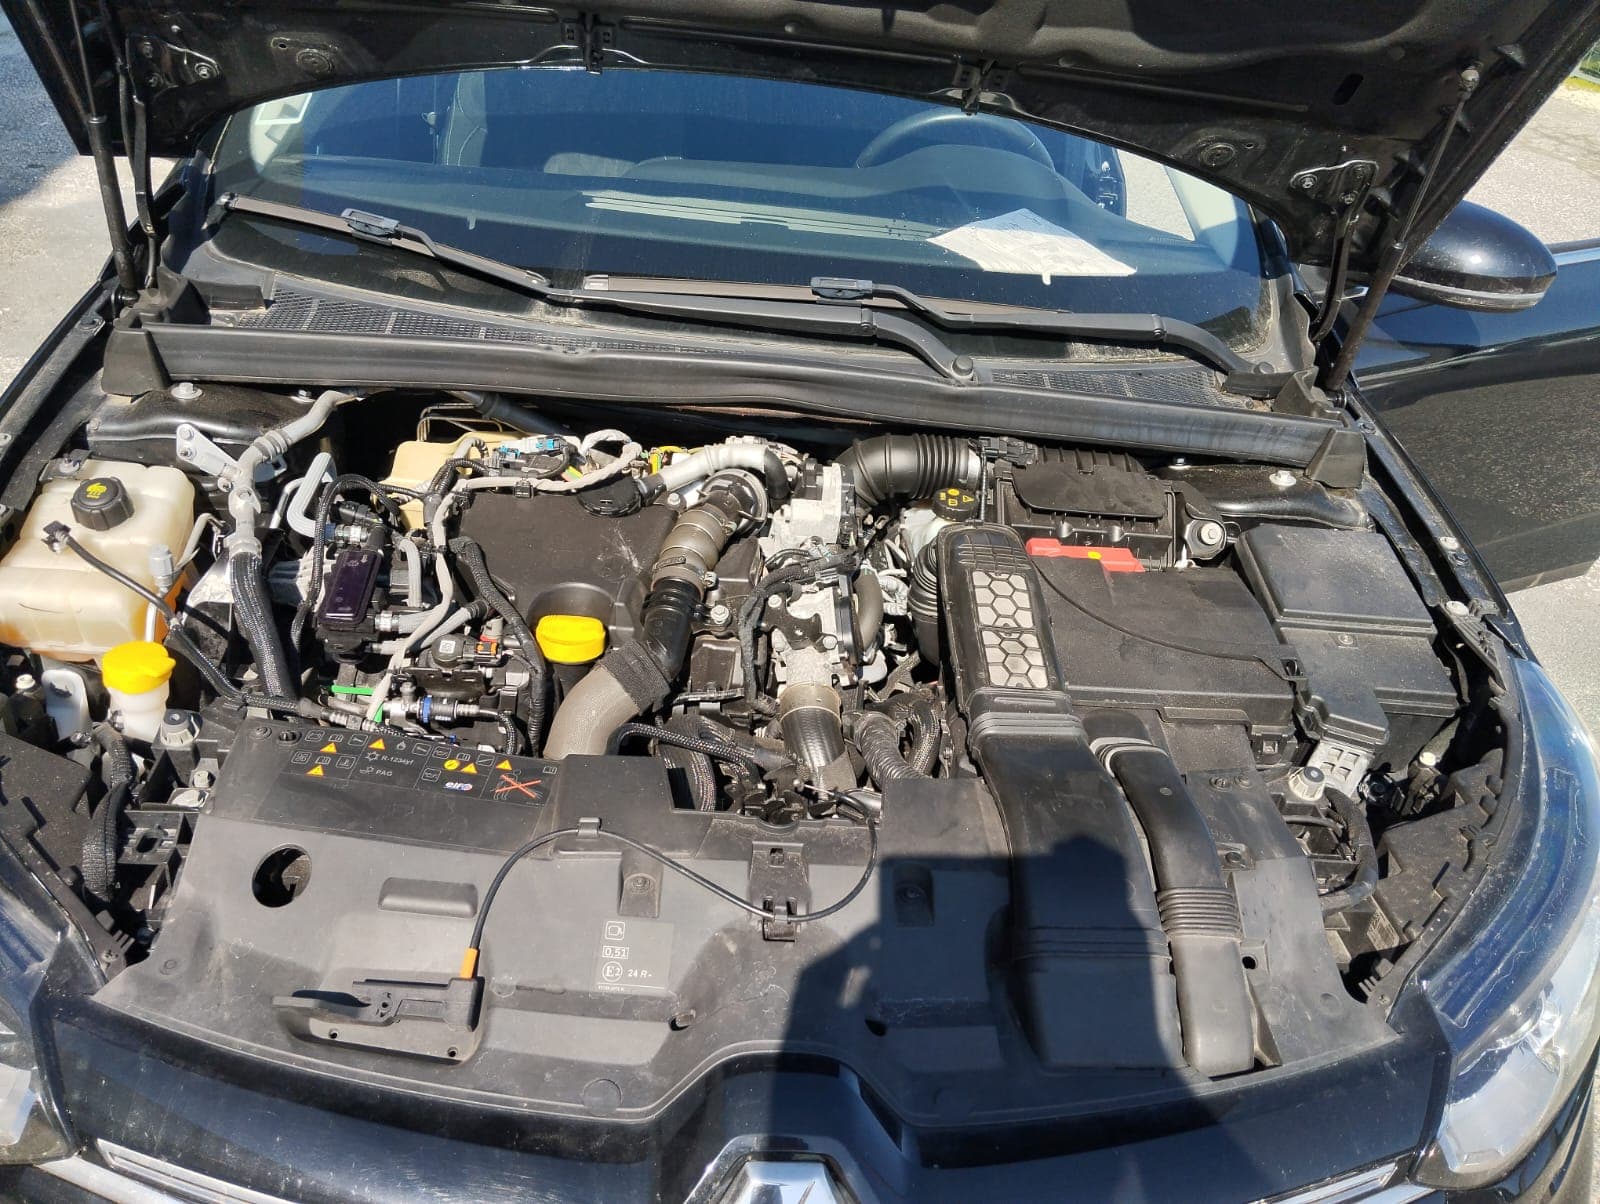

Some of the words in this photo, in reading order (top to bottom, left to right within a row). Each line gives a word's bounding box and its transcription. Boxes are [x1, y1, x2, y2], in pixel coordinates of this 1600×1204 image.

[381, 755, 414, 765] R-1234yf
[376, 769, 393, 777] PAG
[605, 947, 625, 958] 0,51
